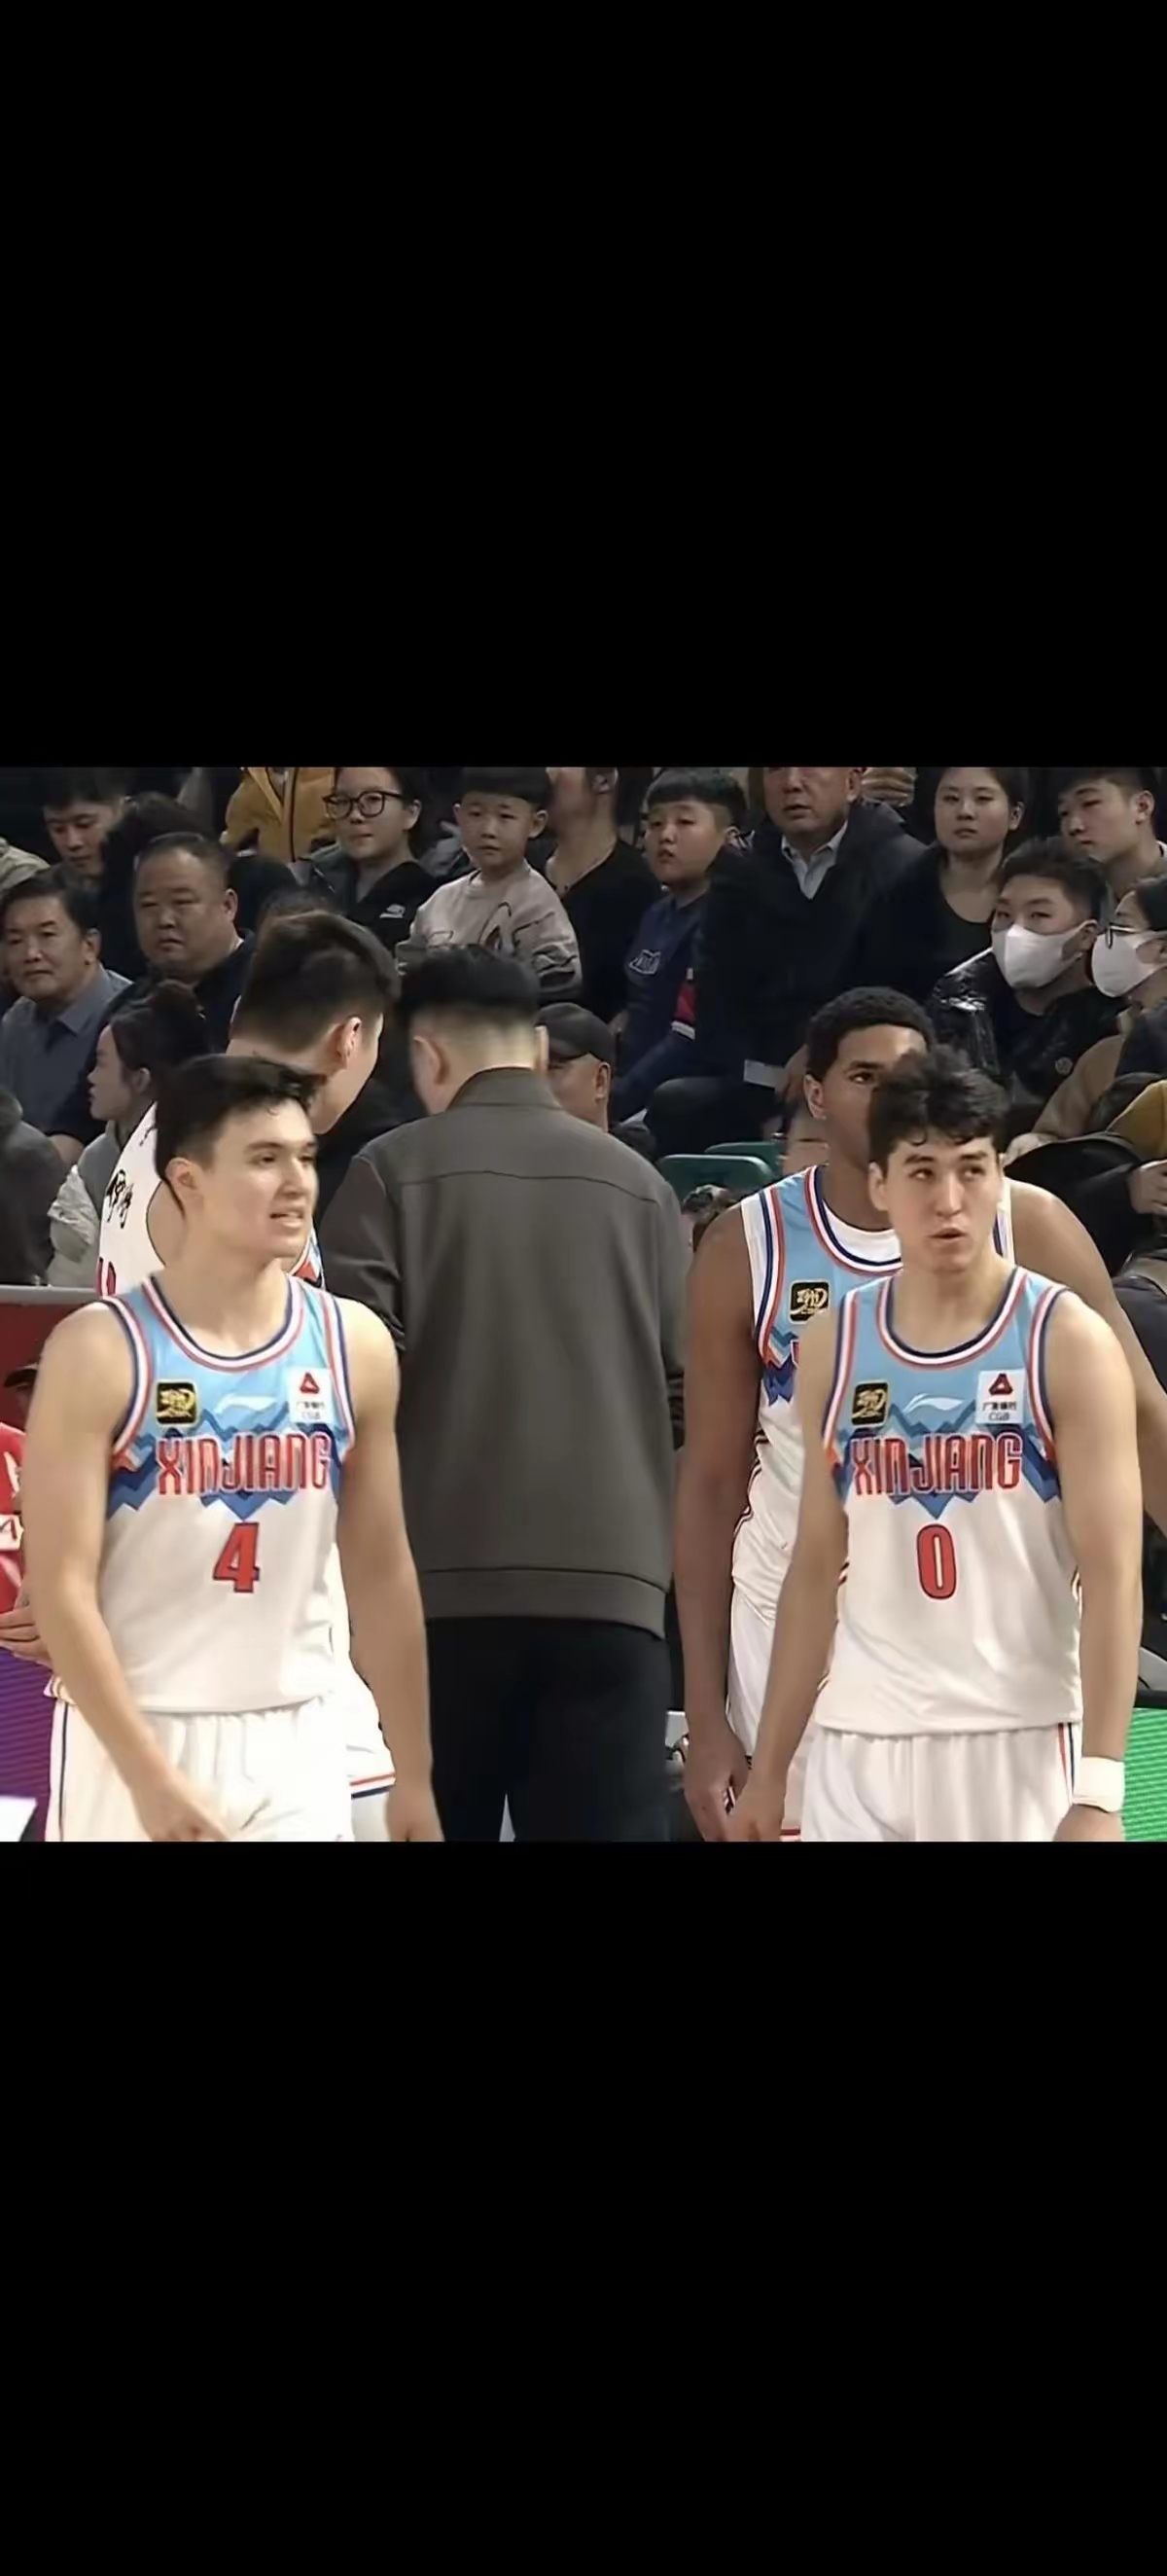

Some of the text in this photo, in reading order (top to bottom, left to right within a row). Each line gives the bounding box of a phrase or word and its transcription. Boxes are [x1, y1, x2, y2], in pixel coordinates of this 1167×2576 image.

[156, 1432, 332, 1495] XINJIANG
[850, 1432, 1023, 1495] XINJIANG
[212, 1521, 260, 1593] 4
[916, 1523, 957, 1600] 0
